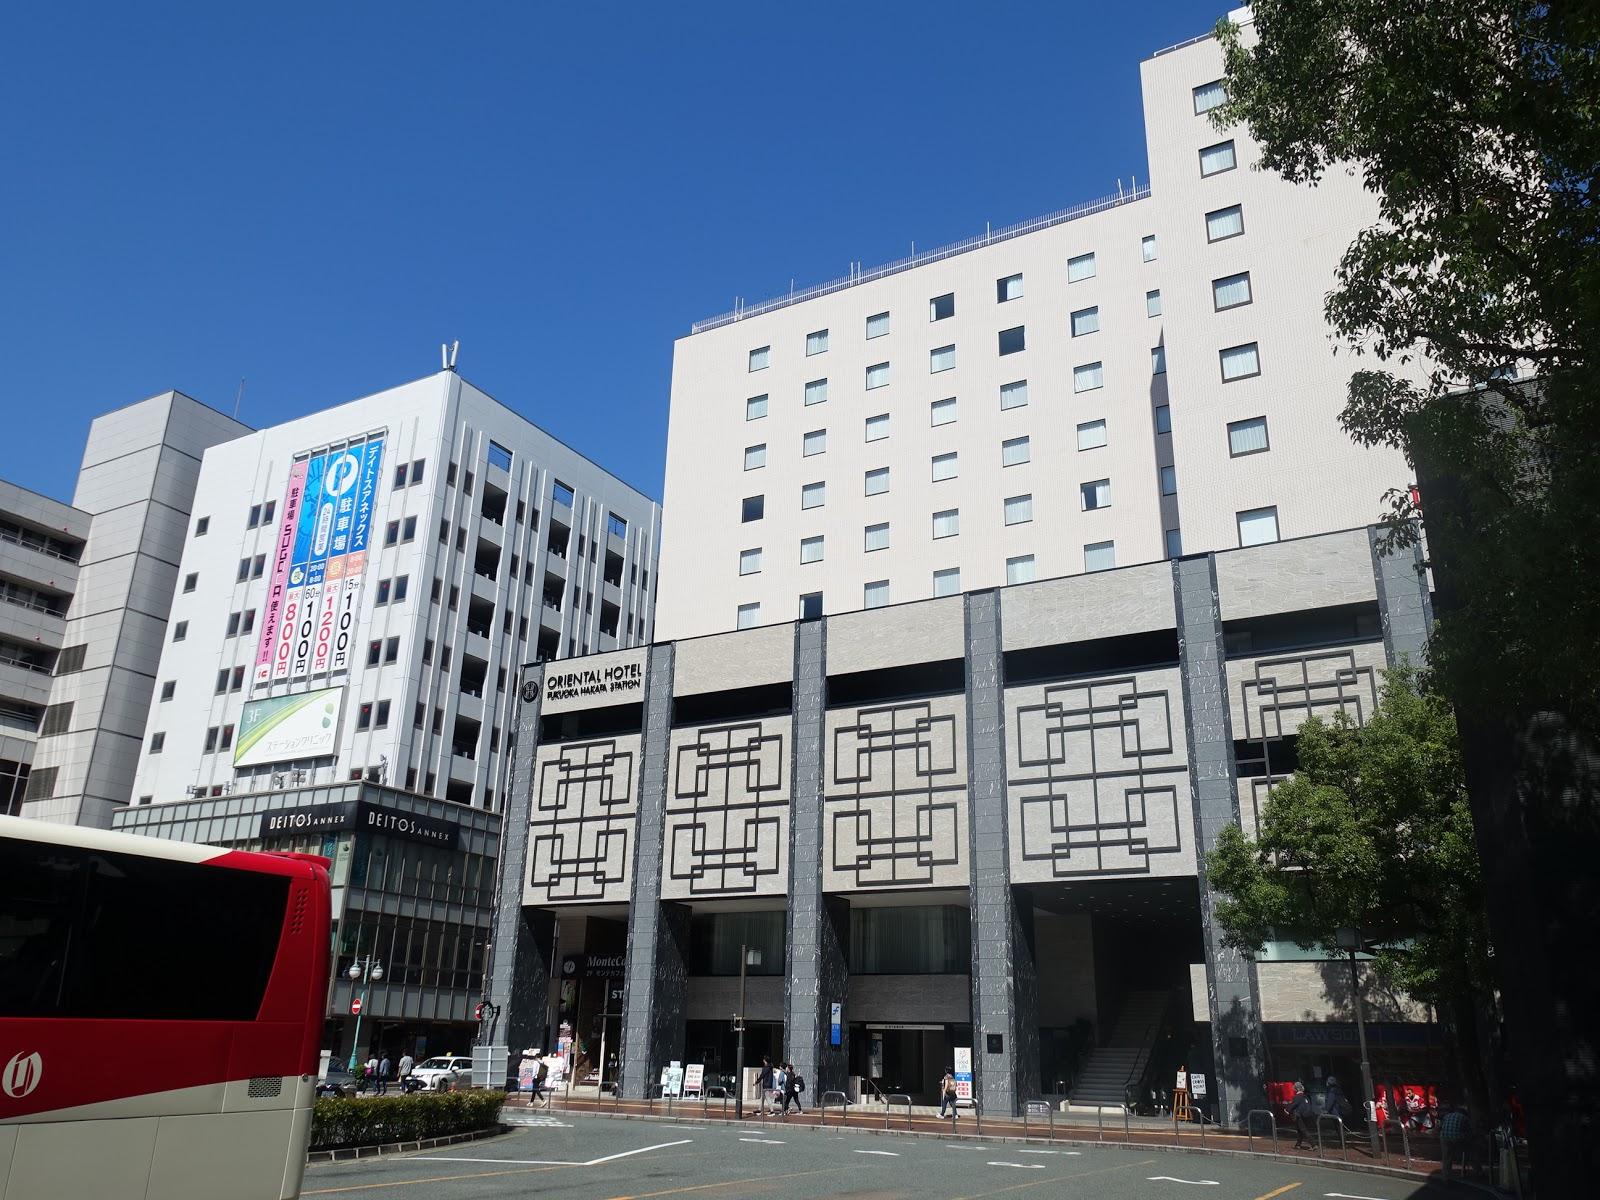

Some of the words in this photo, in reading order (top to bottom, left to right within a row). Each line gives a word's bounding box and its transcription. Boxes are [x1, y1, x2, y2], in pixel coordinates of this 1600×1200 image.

[354, 445, 379, 547] デイトスアネックス
[333, 497, 352, 551] 駐車場
[276, 603, 297, 676] 800円
[294, 601, 314, 674] 100円
[314, 596, 333, 670] 1200円
[334, 592, 353, 666] 100円
[547, 669, 602, 691] ORIENTAL
[604, 663, 642, 682] HOTEL
[547, 688, 580, 701] FUKUOKA
[580, 683, 608, 697] HAKATA
[610, 678, 641, 693] STATION
[246, 708, 262, 724] 3F
[269, 813, 312, 830] DEITOS
[313, 815, 345, 826] ANNEX
[368, 811, 415, 834] DEITOS
[416, 829, 449, 841] ANNEX
